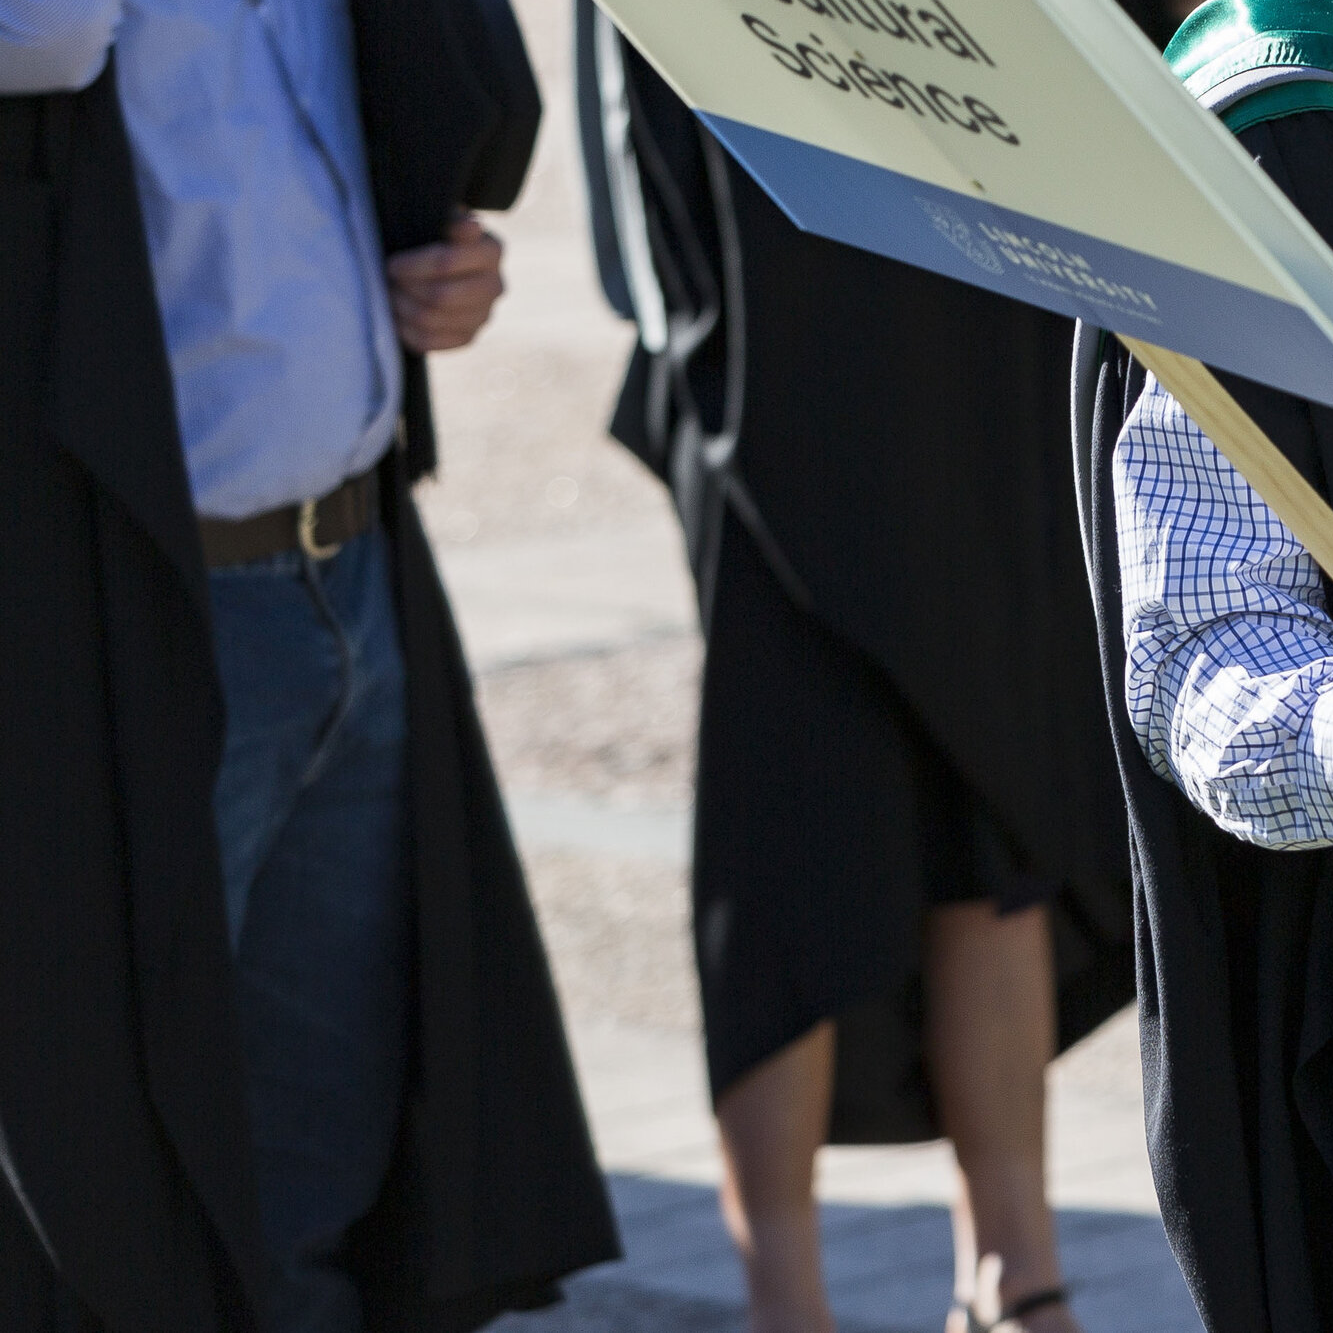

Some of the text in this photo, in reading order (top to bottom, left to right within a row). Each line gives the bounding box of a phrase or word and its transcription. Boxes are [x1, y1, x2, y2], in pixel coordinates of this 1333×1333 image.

[741, 12, 1020, 146] Science
[978, 221, 1093, 271] LINCOLN
[999, 245, 1158, 311] UNIVERSITY
